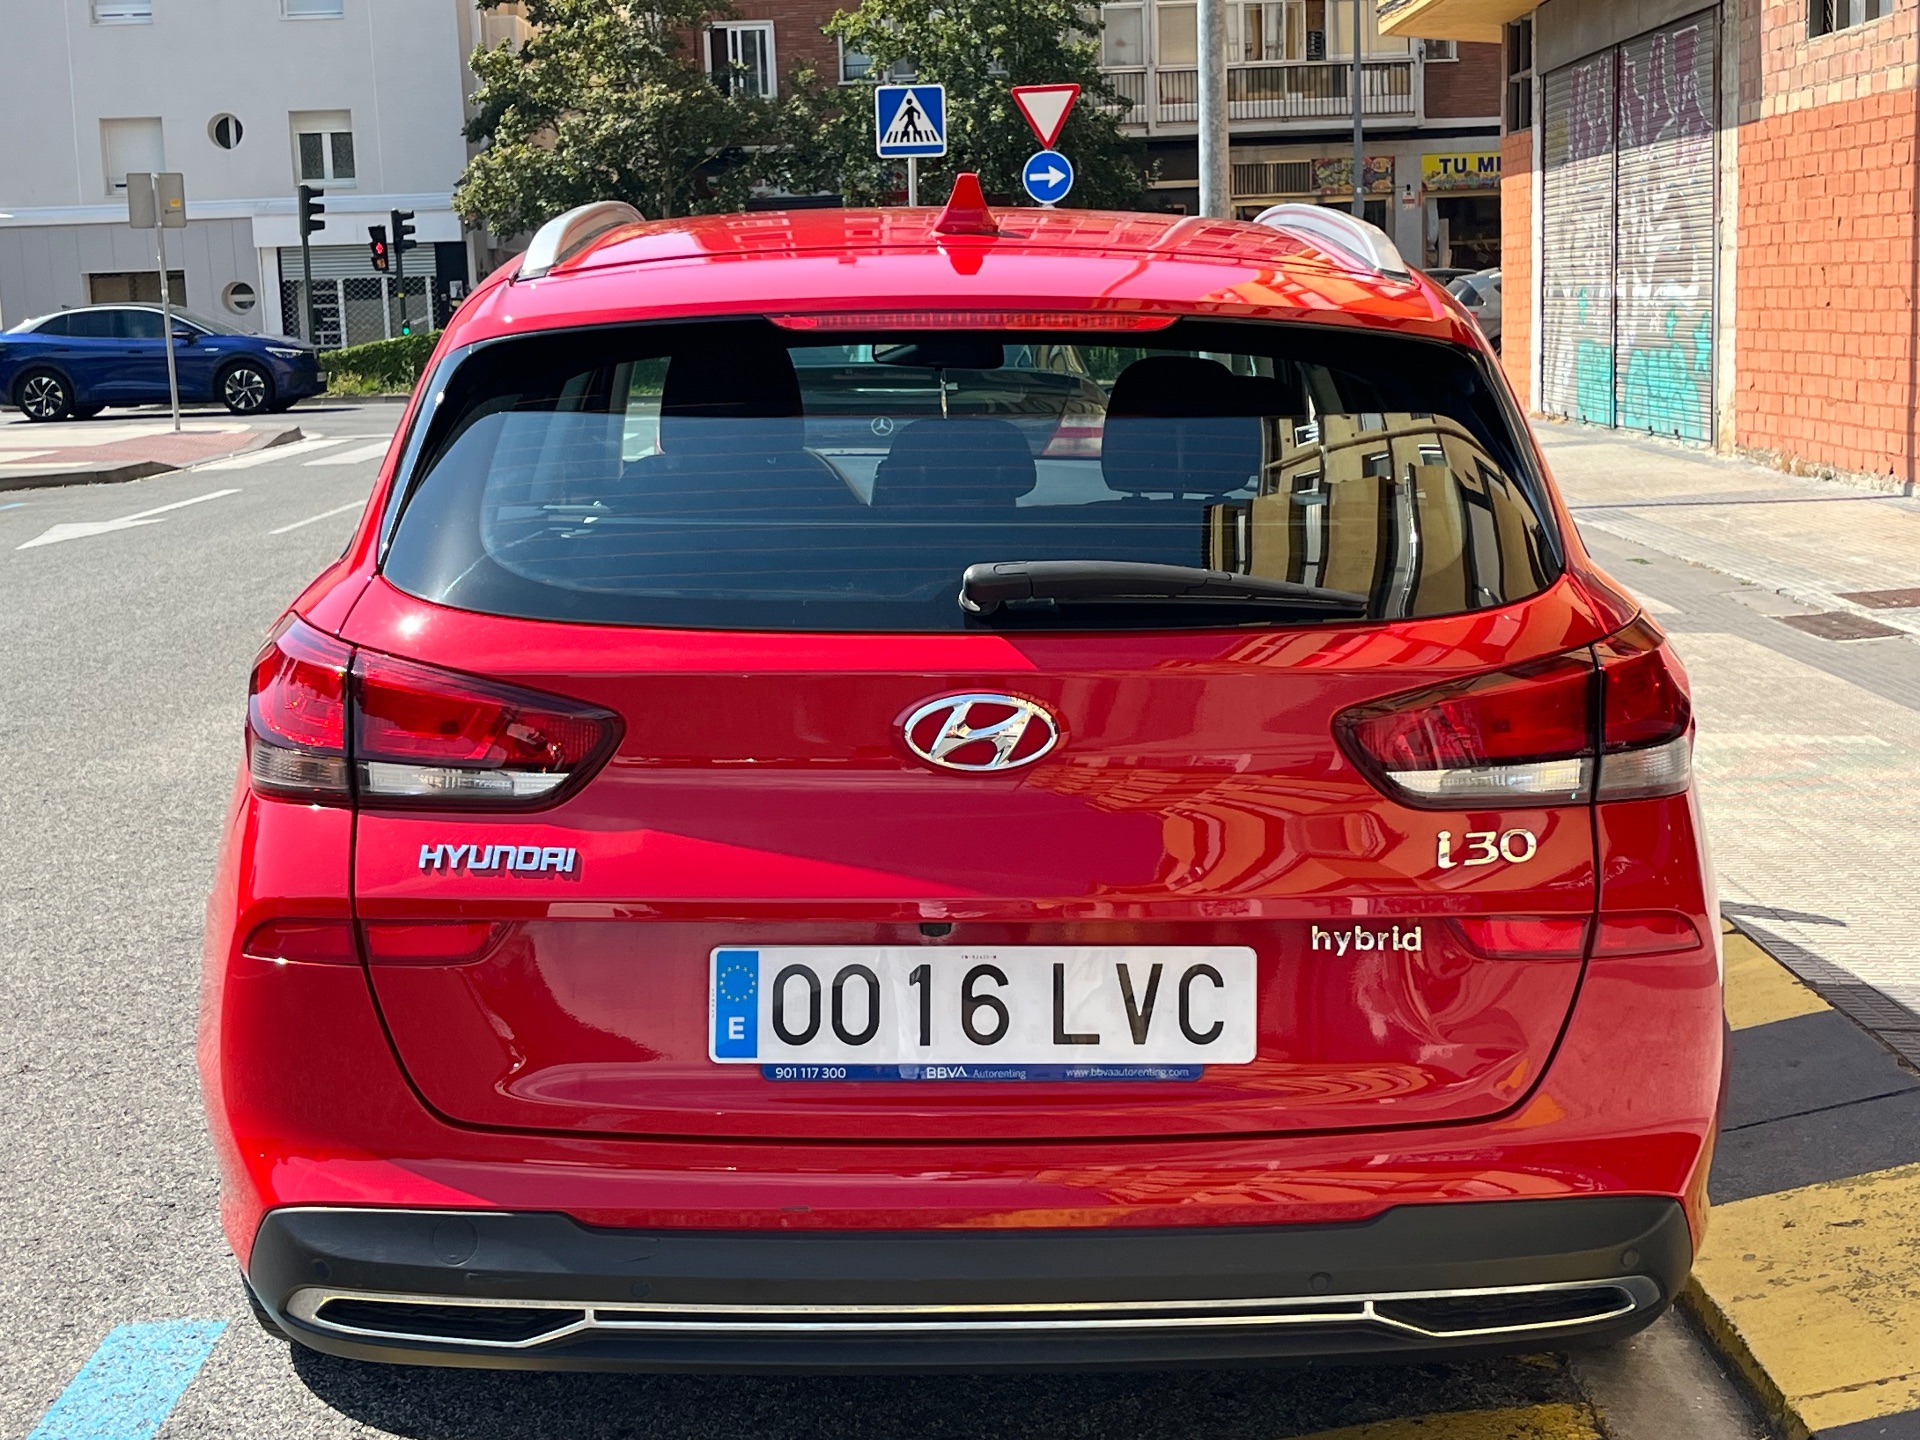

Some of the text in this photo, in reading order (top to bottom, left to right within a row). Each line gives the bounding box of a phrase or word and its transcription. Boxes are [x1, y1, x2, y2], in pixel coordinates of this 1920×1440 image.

[1440, 158, 1467, 174] TU
[418, 844, 576, 872] HYUNDAI
[1311, 925, 1422, 957] hybrid
[772, 962, 1225, 1046] 0016 LVC
[728, 1016, 745, 1039] E
[775, 1067, 846, 1079] 901 117 300
[926, 1066, 1027, 1080] BBVA Autorenting
